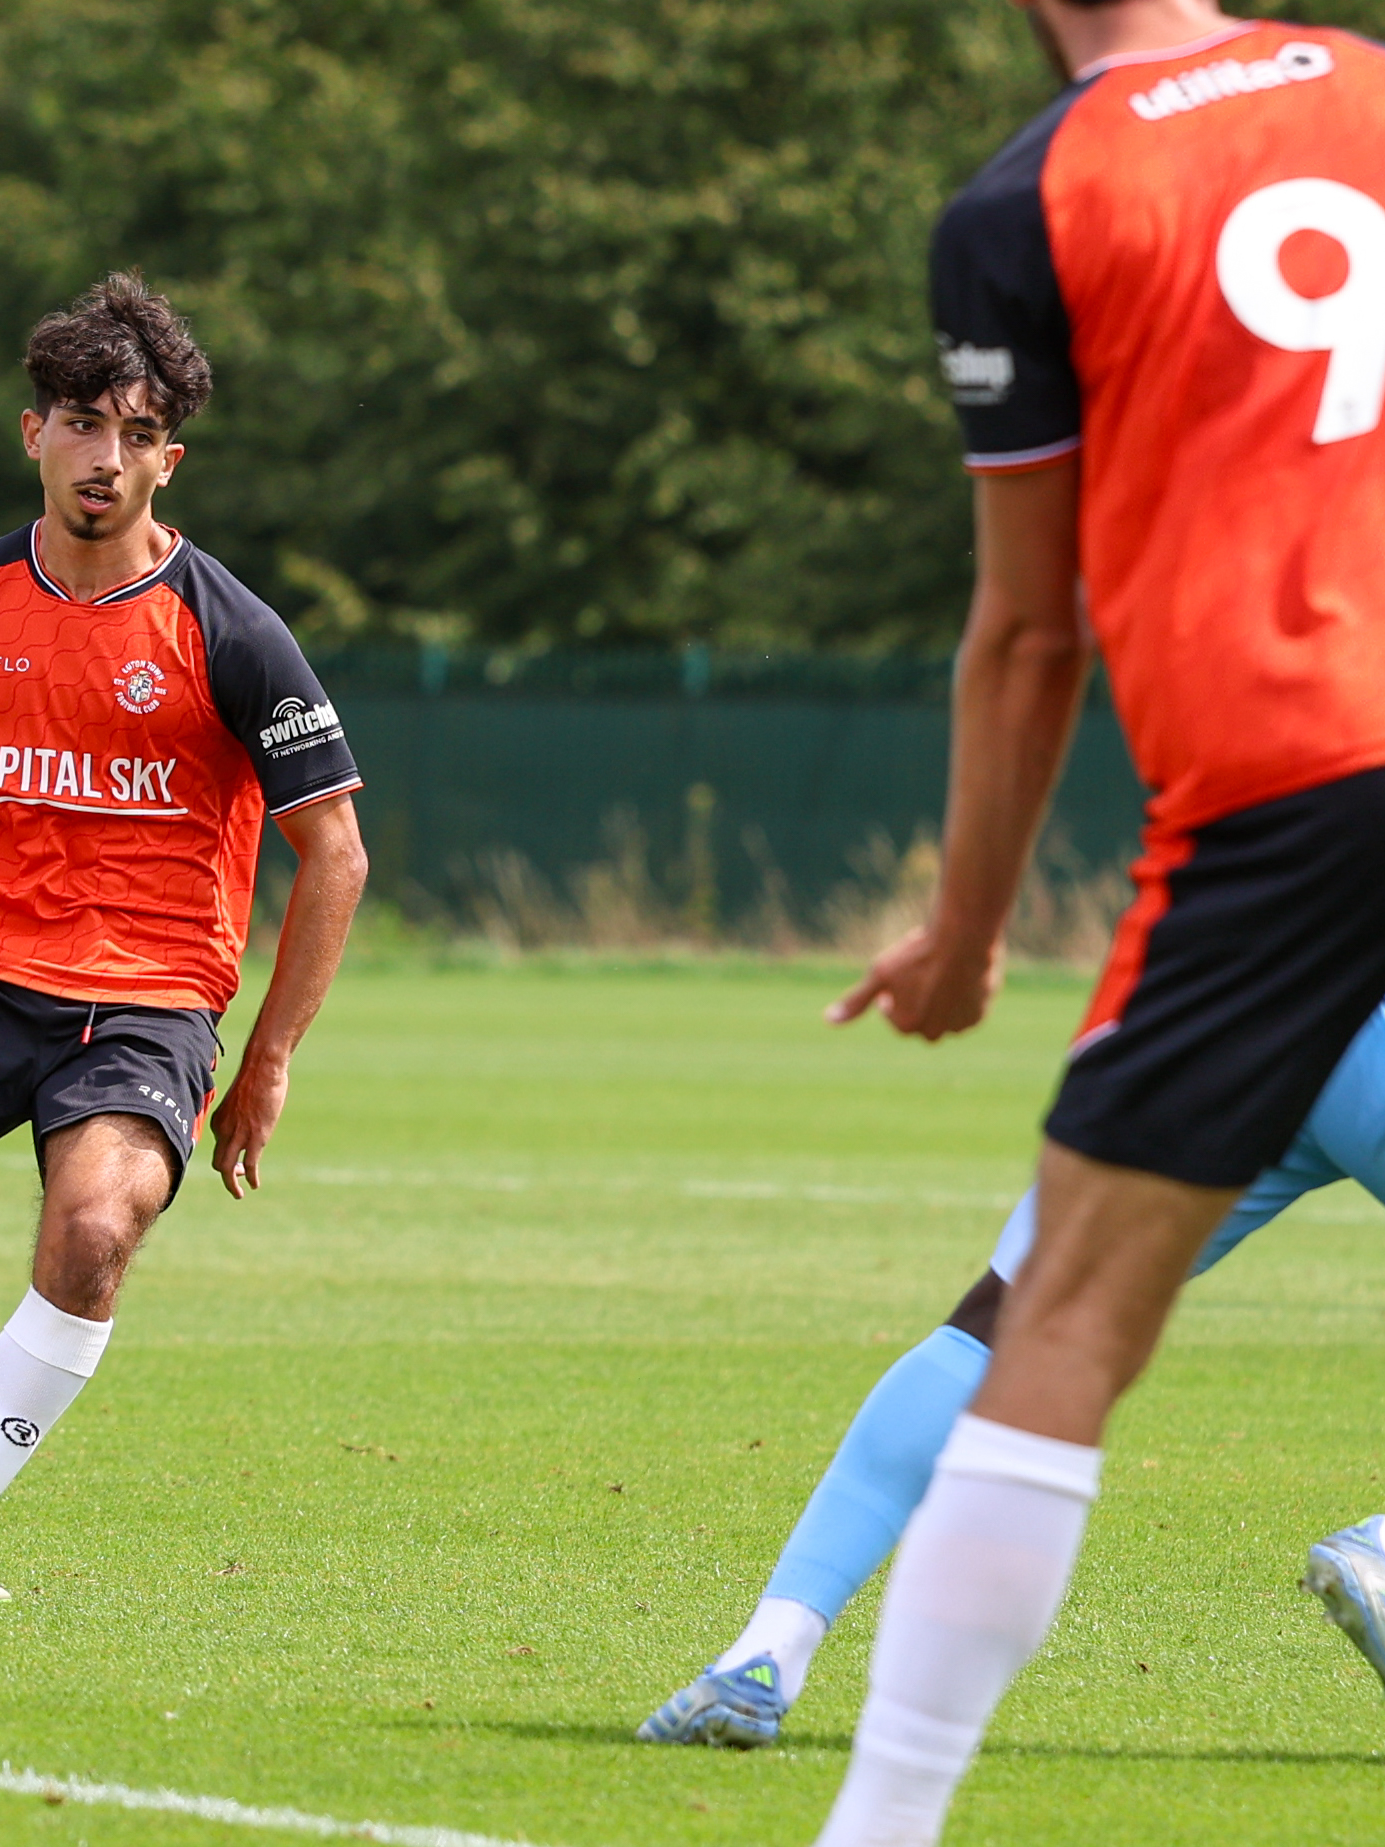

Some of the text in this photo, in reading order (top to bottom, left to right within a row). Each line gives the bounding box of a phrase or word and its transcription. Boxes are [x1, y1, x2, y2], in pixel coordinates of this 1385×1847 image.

[1215, 177, 1385, 446] 9
[121, 660, 165, 681] LUTON TOWN
[115, 691, 160, 714] FOOTBALL CLUB
[280, 736, 327, 757] NETWORKING
[110, 757, 177, 803] SKY
[138, 1085, 189, 1135] REFLO
